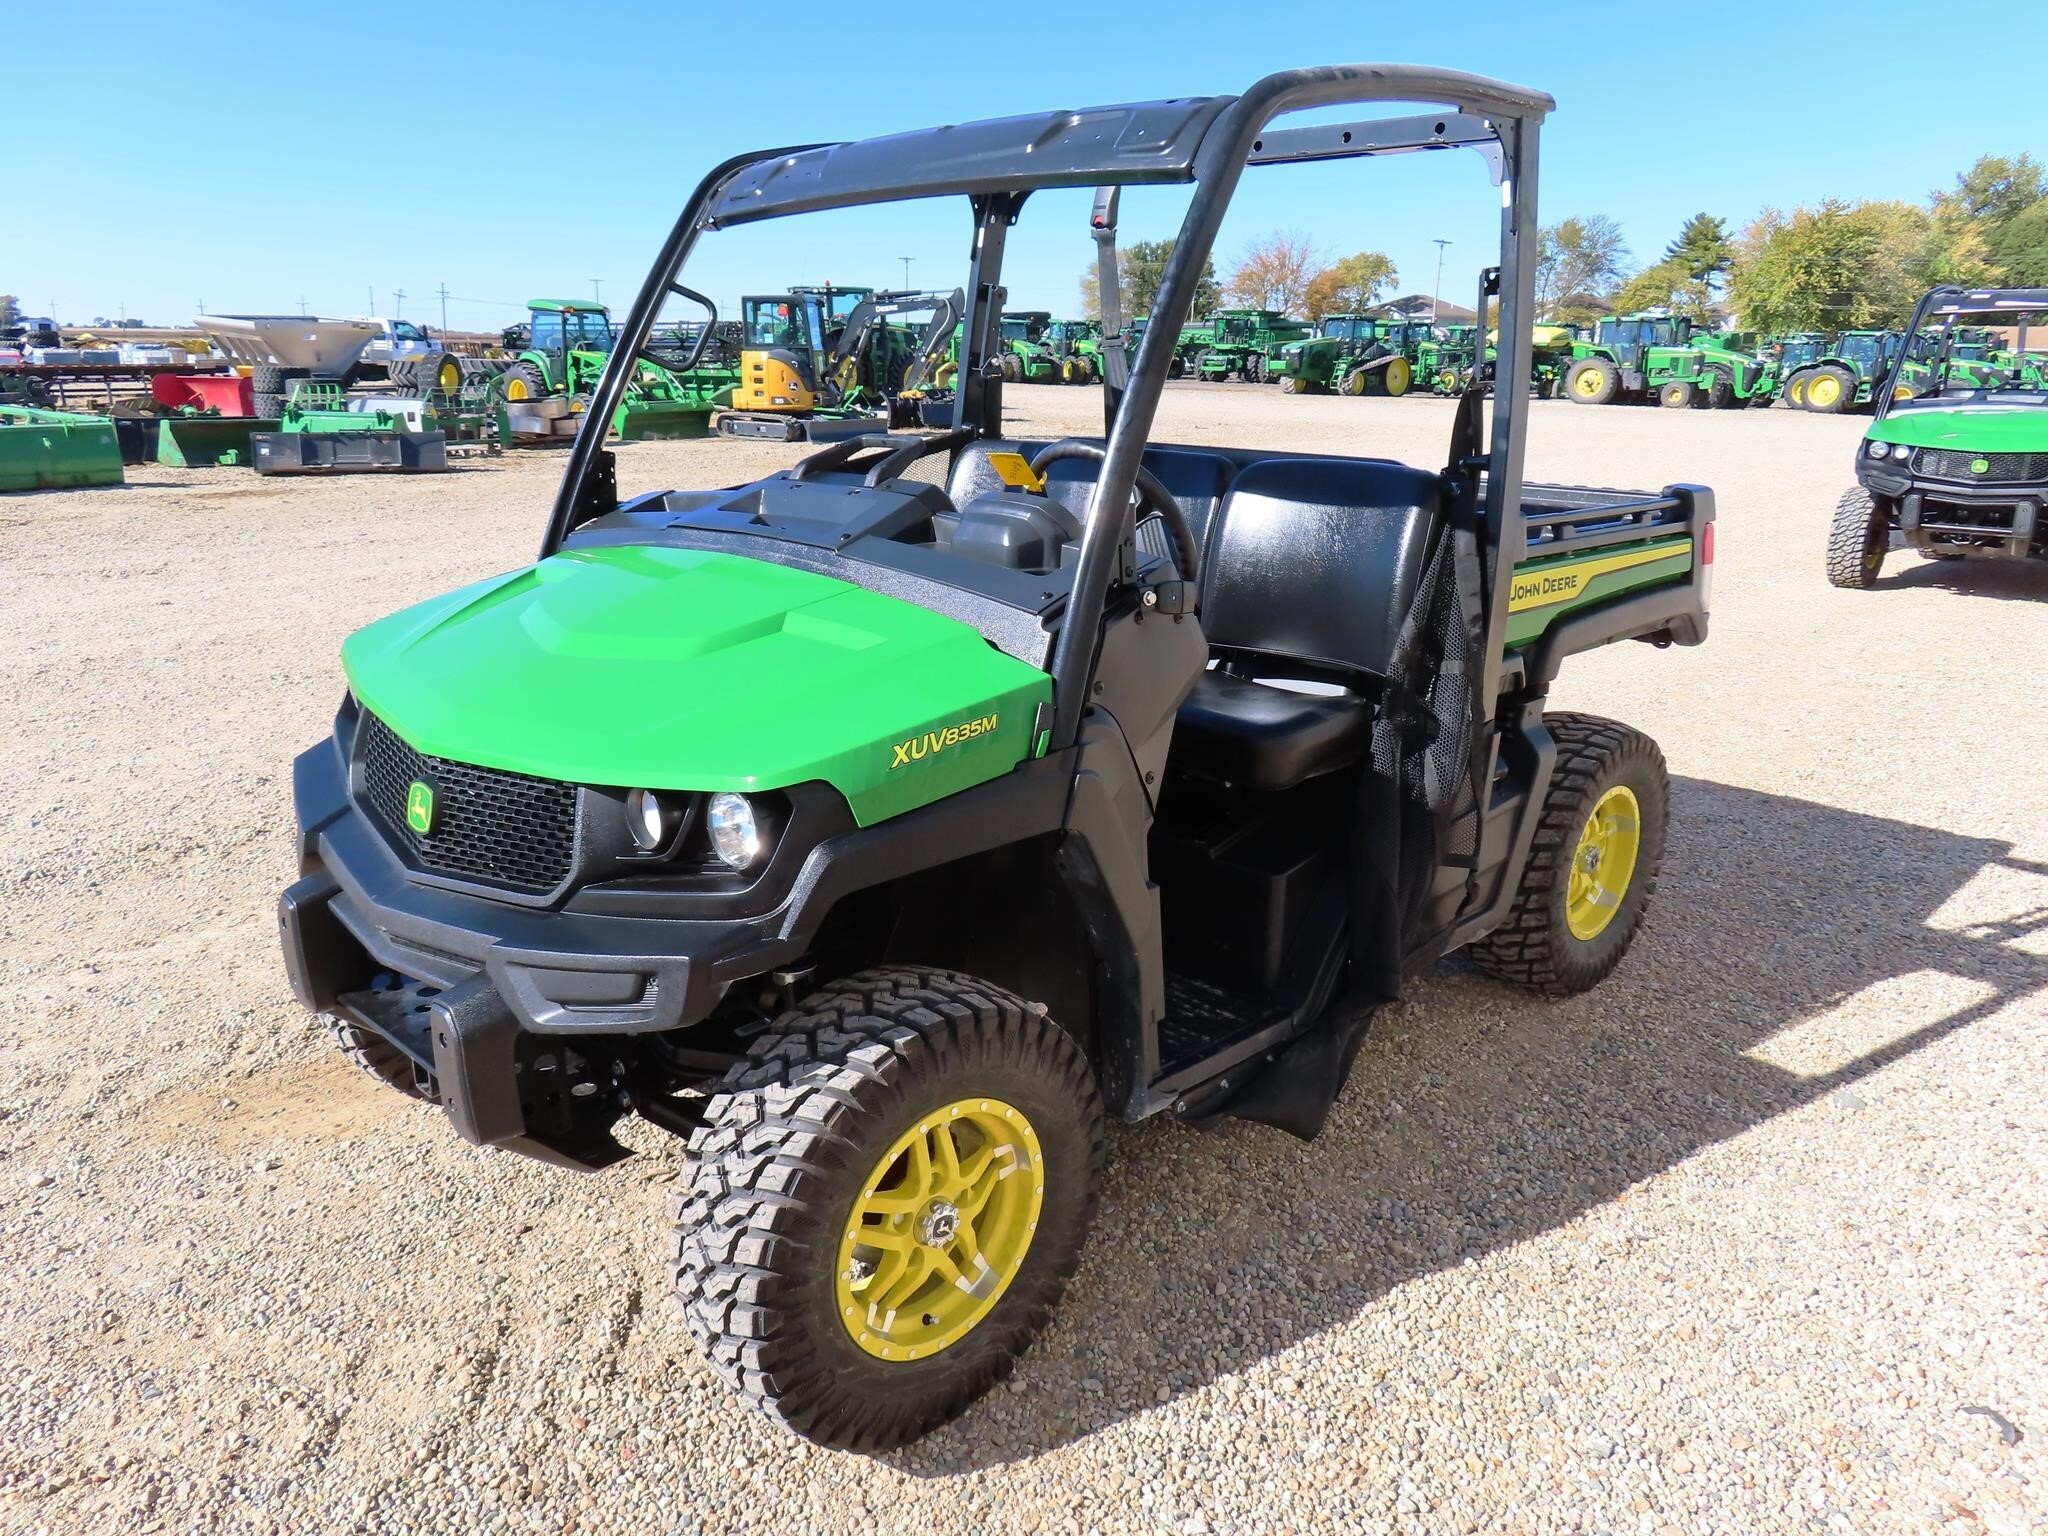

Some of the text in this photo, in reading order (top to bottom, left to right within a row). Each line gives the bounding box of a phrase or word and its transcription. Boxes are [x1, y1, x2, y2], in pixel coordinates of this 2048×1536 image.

[875, 304, 898, 312] DEERE
[1510, 574, 1577, 602] JOHN DEERE
[890, 713, 998, 769] XUV835M
